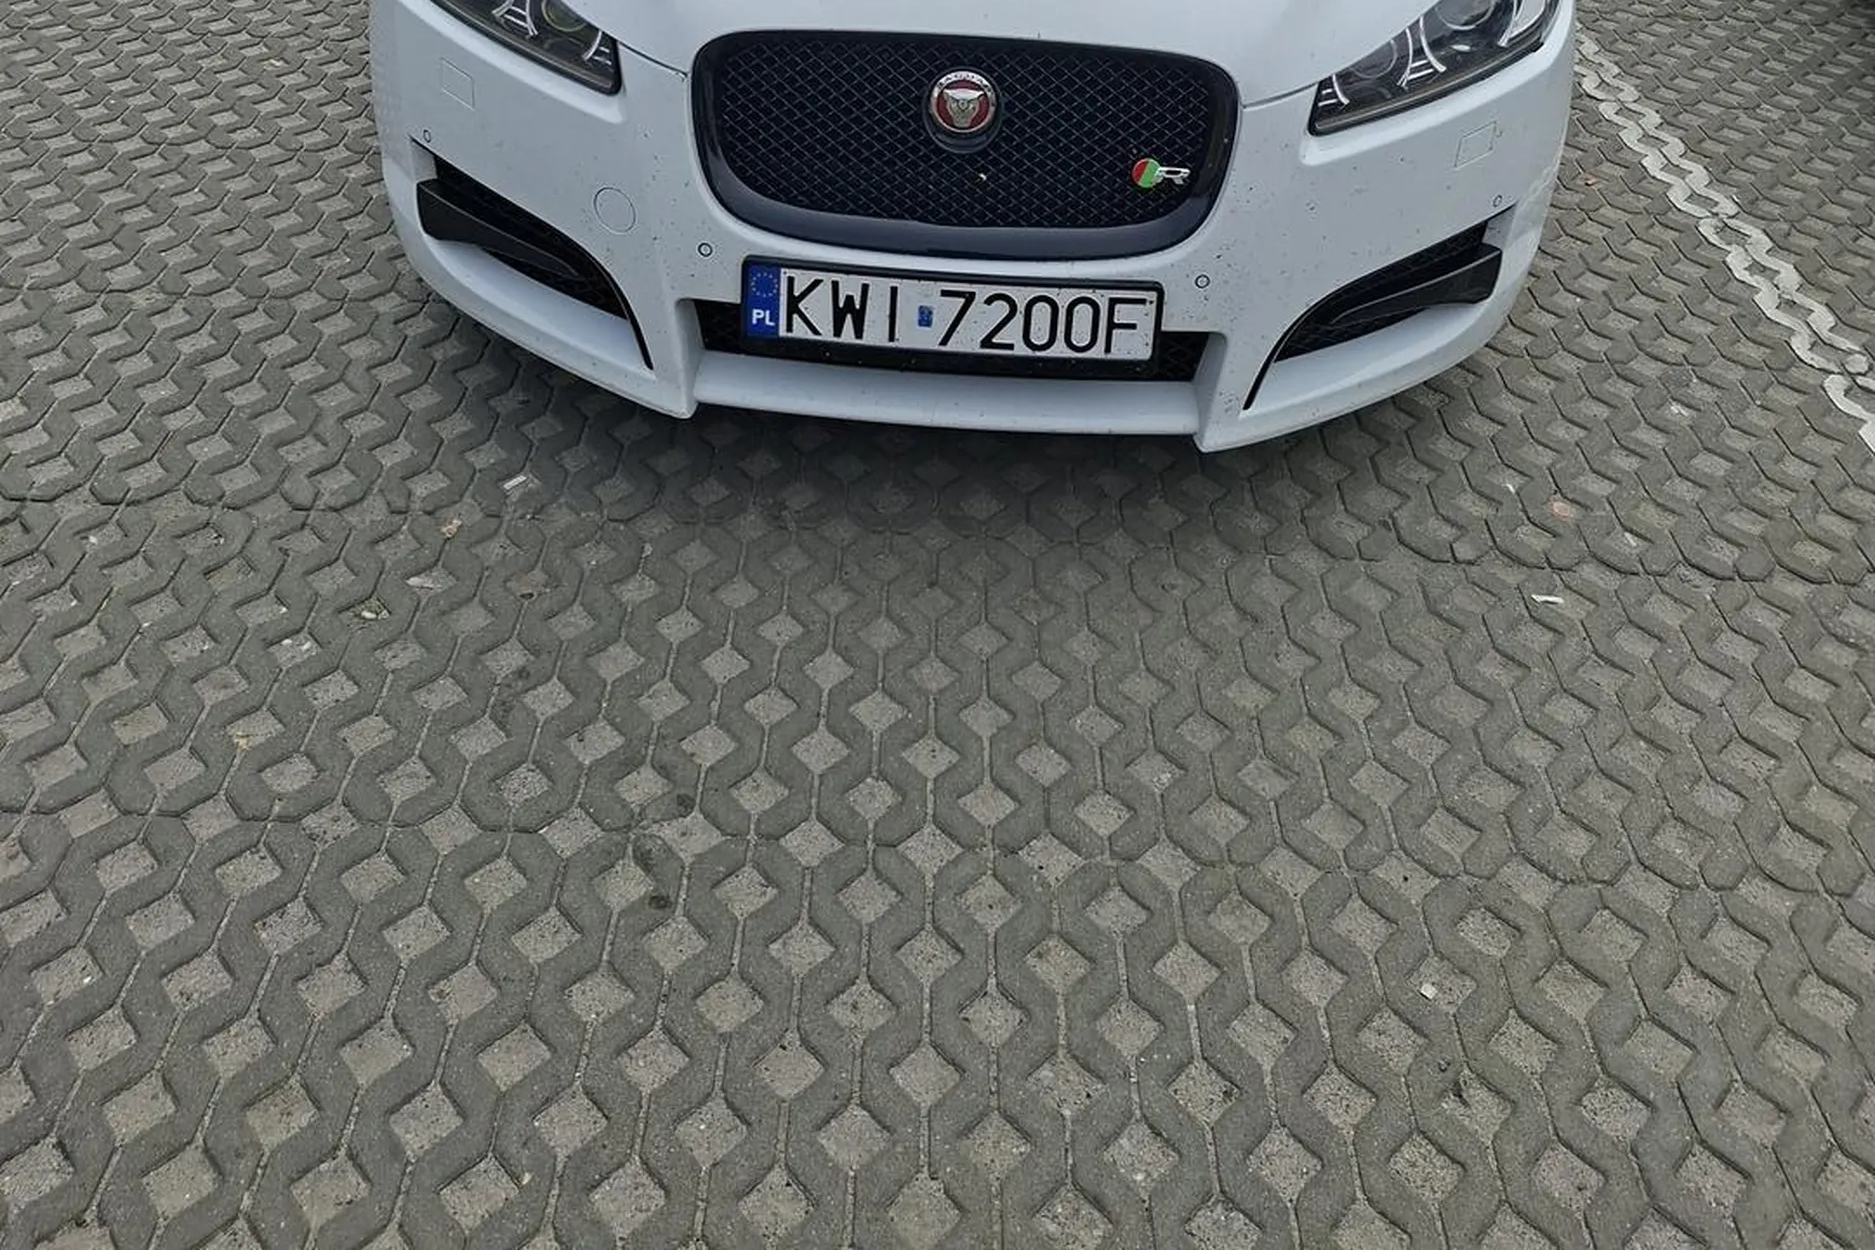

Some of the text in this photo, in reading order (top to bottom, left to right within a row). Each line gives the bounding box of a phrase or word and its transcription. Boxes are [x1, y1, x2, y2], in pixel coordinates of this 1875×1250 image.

[751, 310, 776, 327] PL
[785, 275, 1149, 355] KWI 7200F
